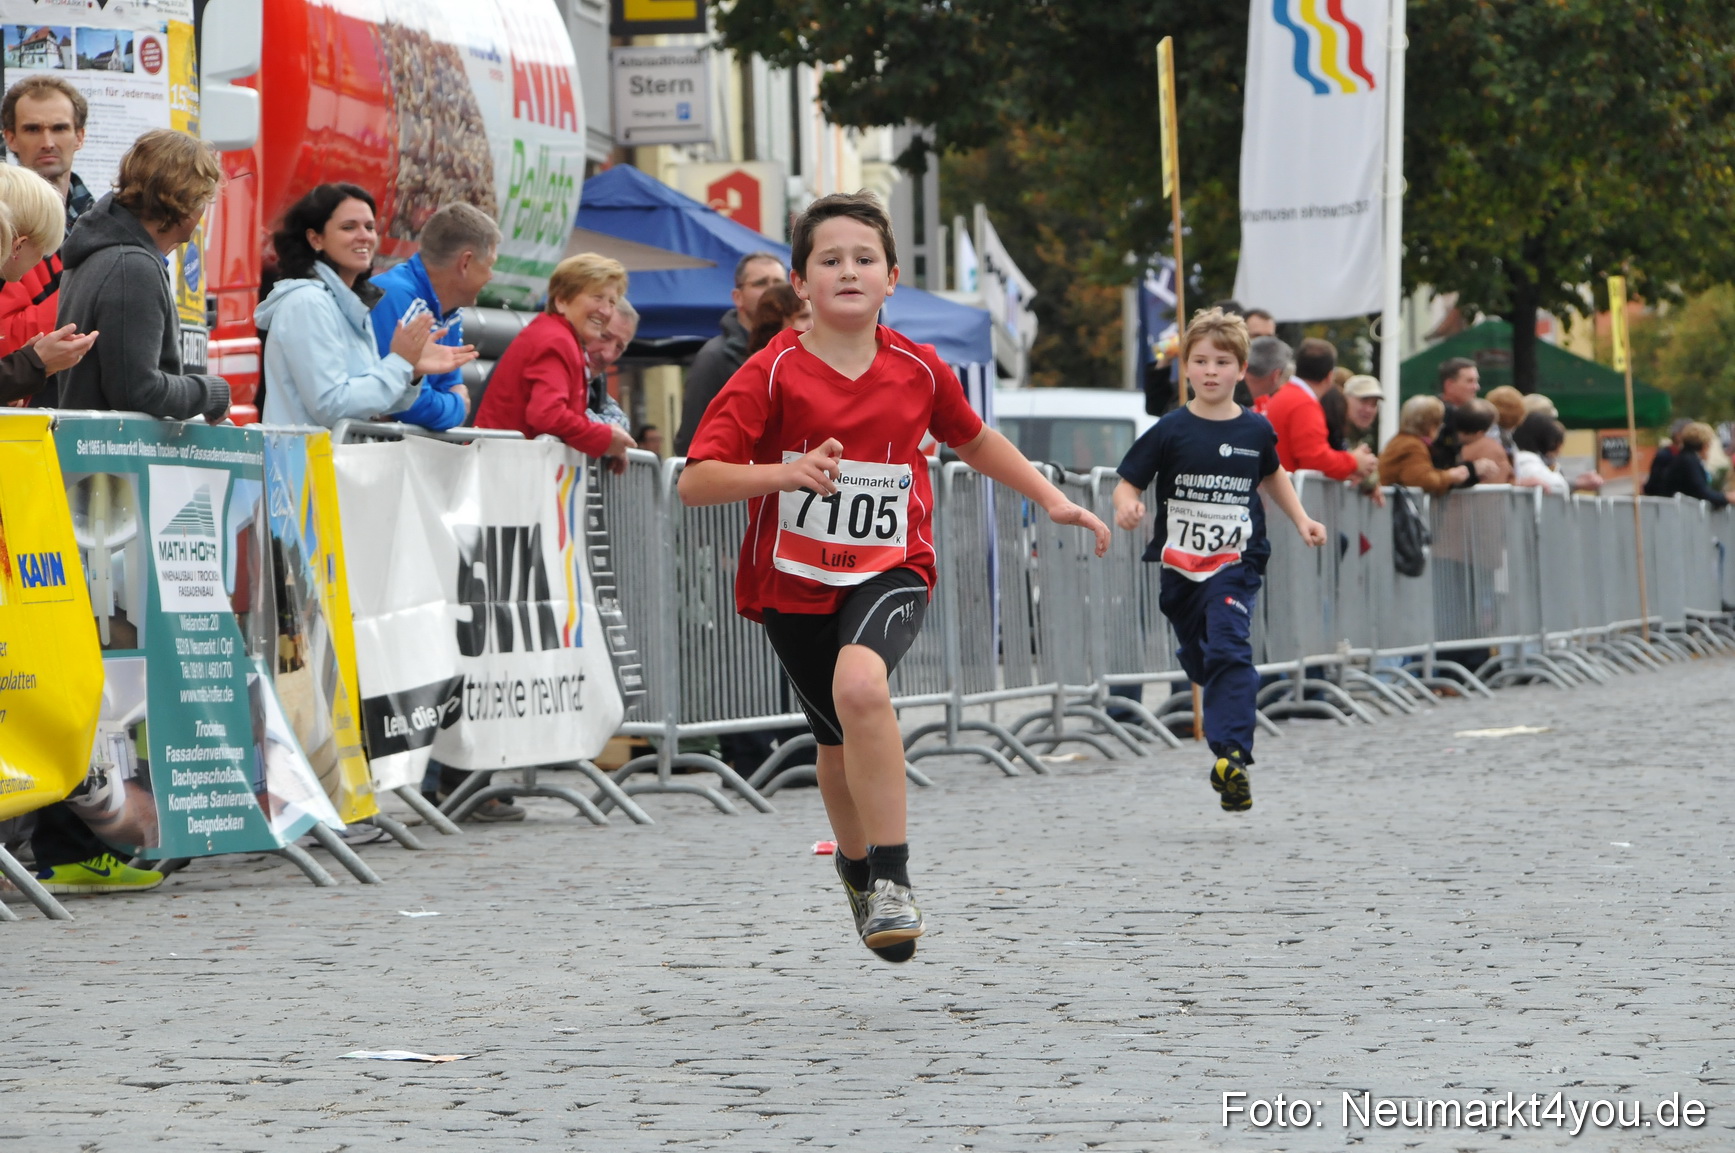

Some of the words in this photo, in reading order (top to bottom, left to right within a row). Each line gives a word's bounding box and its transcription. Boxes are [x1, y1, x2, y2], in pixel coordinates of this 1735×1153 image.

[508, 42, 578, 133] AVIA
[630, 75, 694, 96] Stern
[499, 138, 574, 248] Pellets
[796, 486, 899, 540] 7105
[1197, 510, 1239, 522] Neumarkt
[1176, 518, 1242, 552] 7534
[821, 547, 857, 568] Luis
[411, 705, 438, 731] die
[168, 791, 209, 814] Komplette
[187, 813, 244, 837] Designdecken
